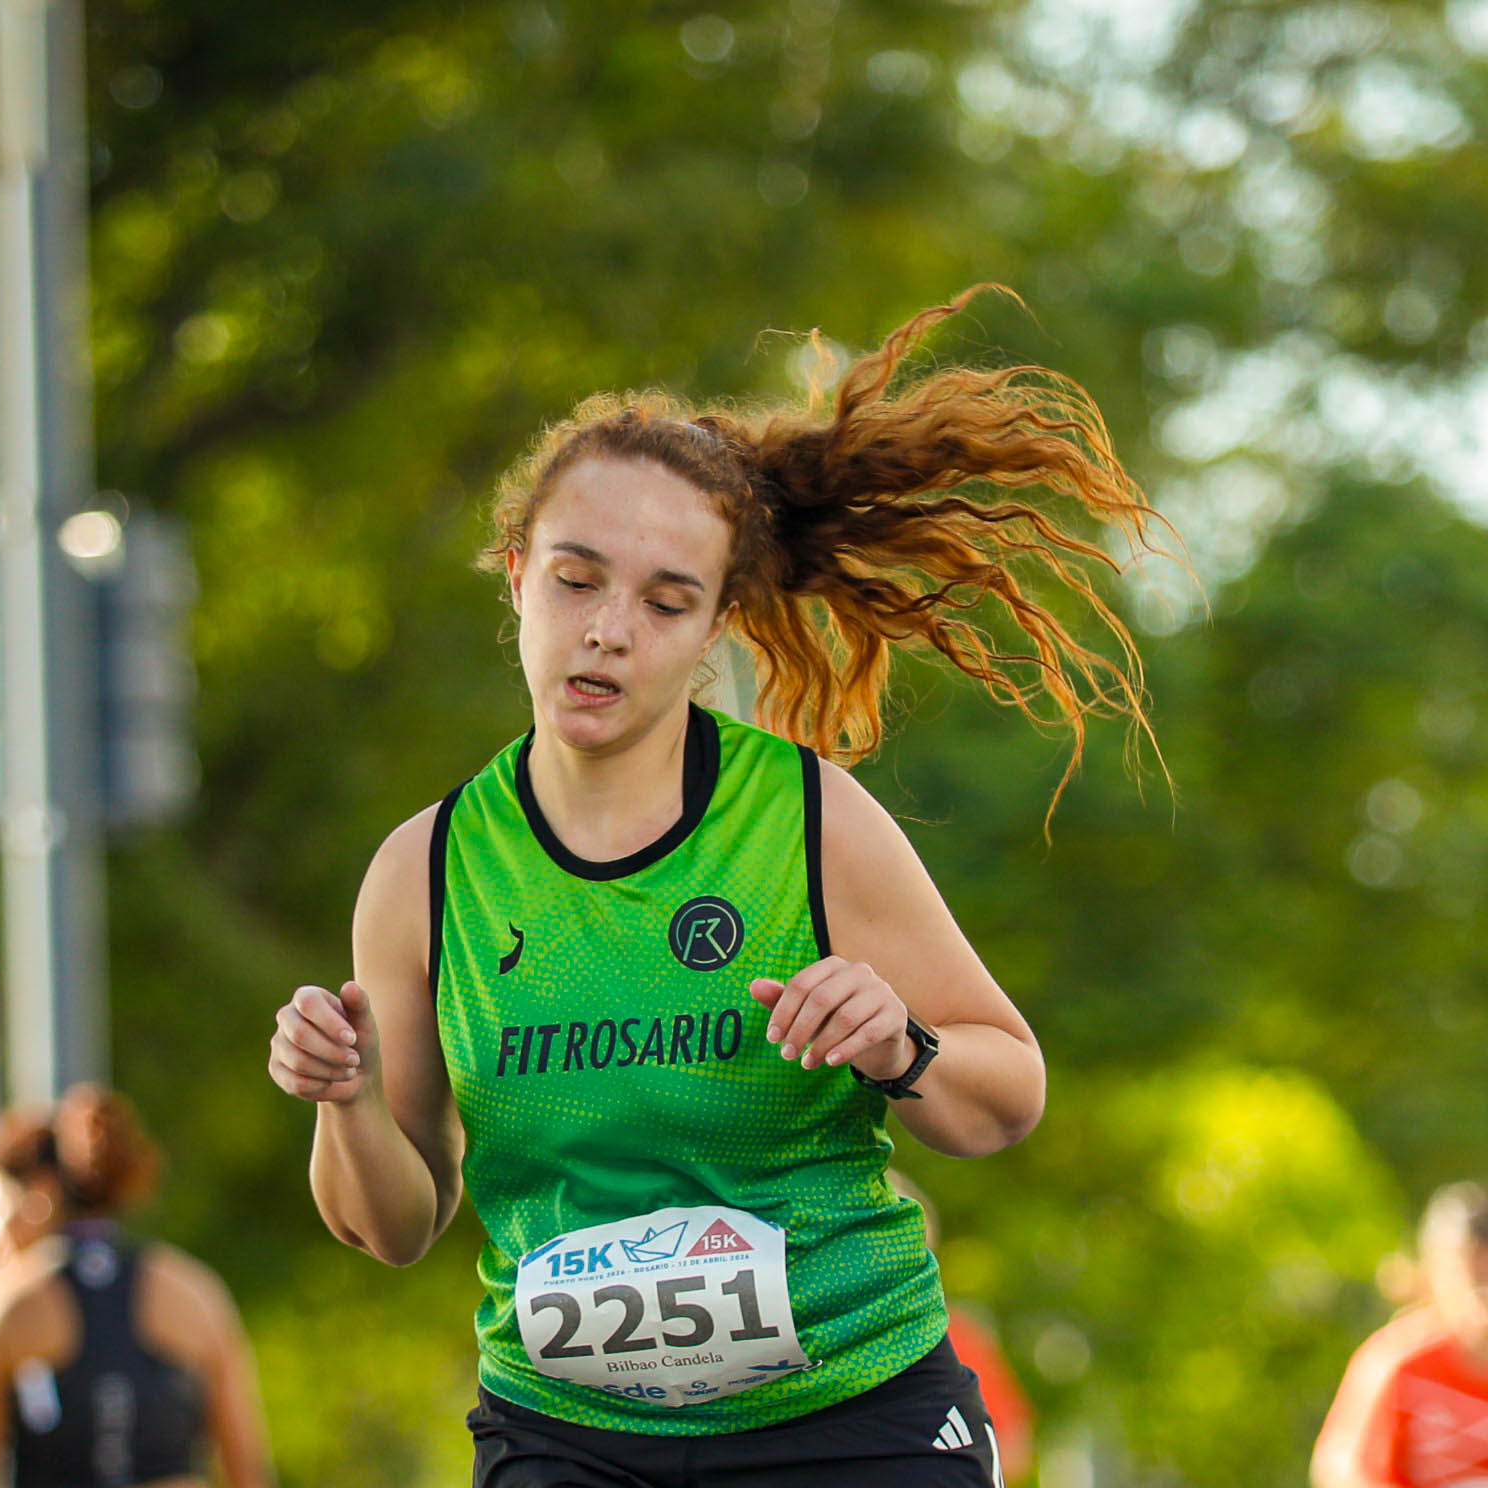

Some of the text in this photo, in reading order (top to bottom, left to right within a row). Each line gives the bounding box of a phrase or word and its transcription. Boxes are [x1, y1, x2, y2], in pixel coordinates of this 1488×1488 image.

[495, 1008, 743, 1077] FITROSARIO
[700, 1233, 739, 1250] 15K
[546, 1242, 615, 1278] 15K
[634, 1263, 669, 1273] ROSARIO
[703, 1256, 727, 1264] ABRIL
[530, 1269, 780, 1360] 2251
[606, 1352, 725, 1374] Bilbao Candela
